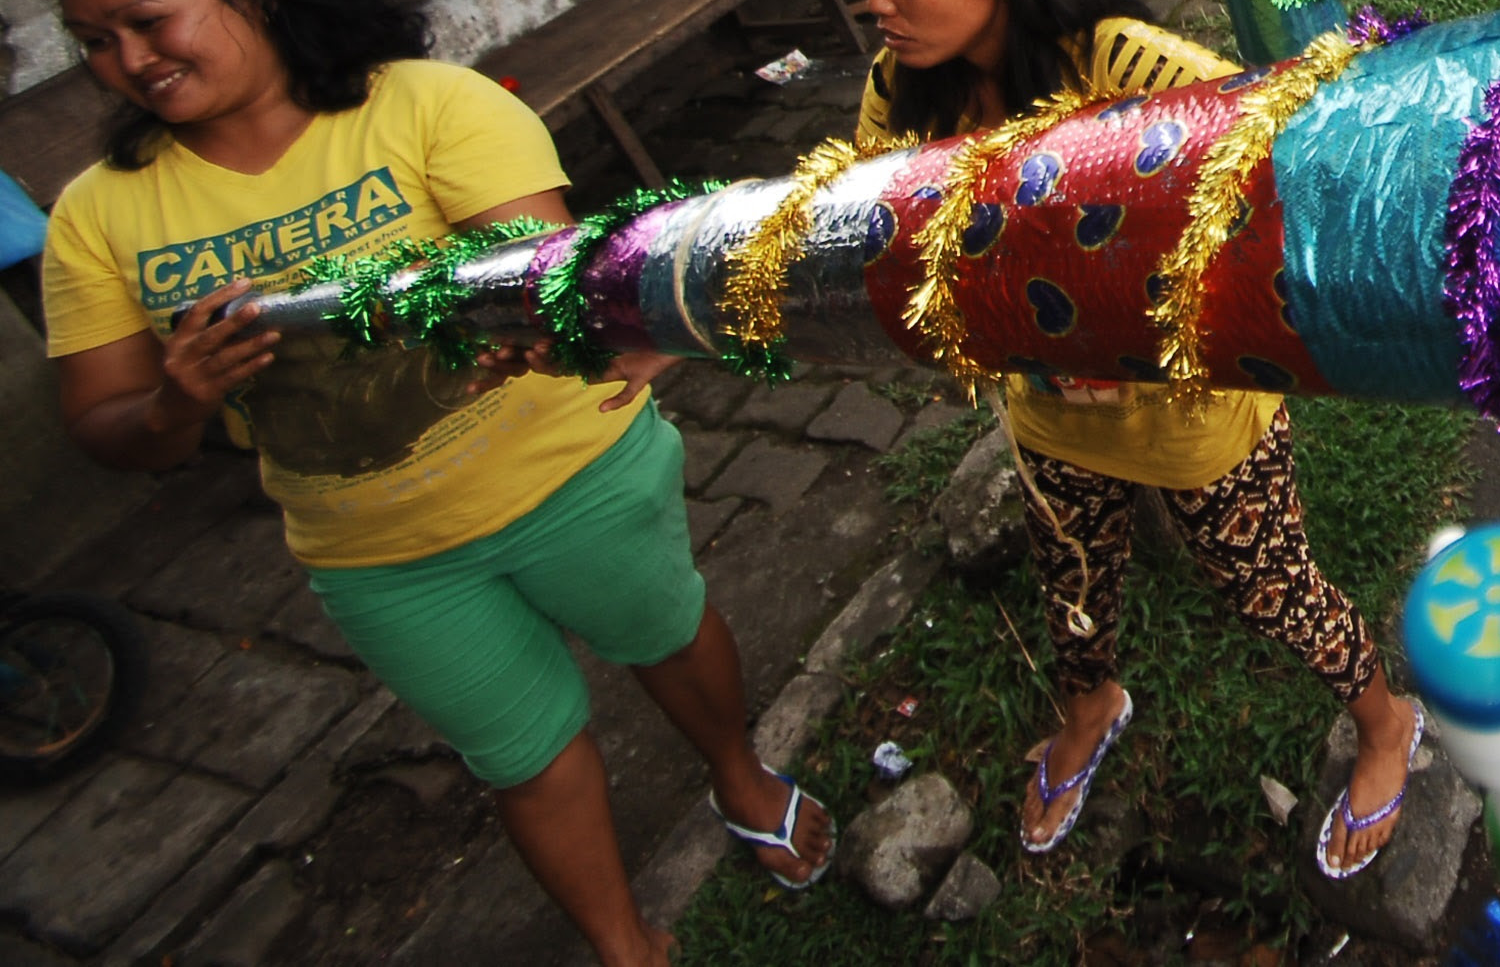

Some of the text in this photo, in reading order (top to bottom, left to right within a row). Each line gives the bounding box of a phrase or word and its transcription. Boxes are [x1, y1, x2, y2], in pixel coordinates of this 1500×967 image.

[144, 175, 403, 294] CAMERA
[147, 285, 199, 305] SHOW
[214, 268, 264, 288] AND
[275, 238, 331, 266] SWAP
[344, 208, 399, 239] MEET
[184, 190, 347, 255] VANCOUVER
